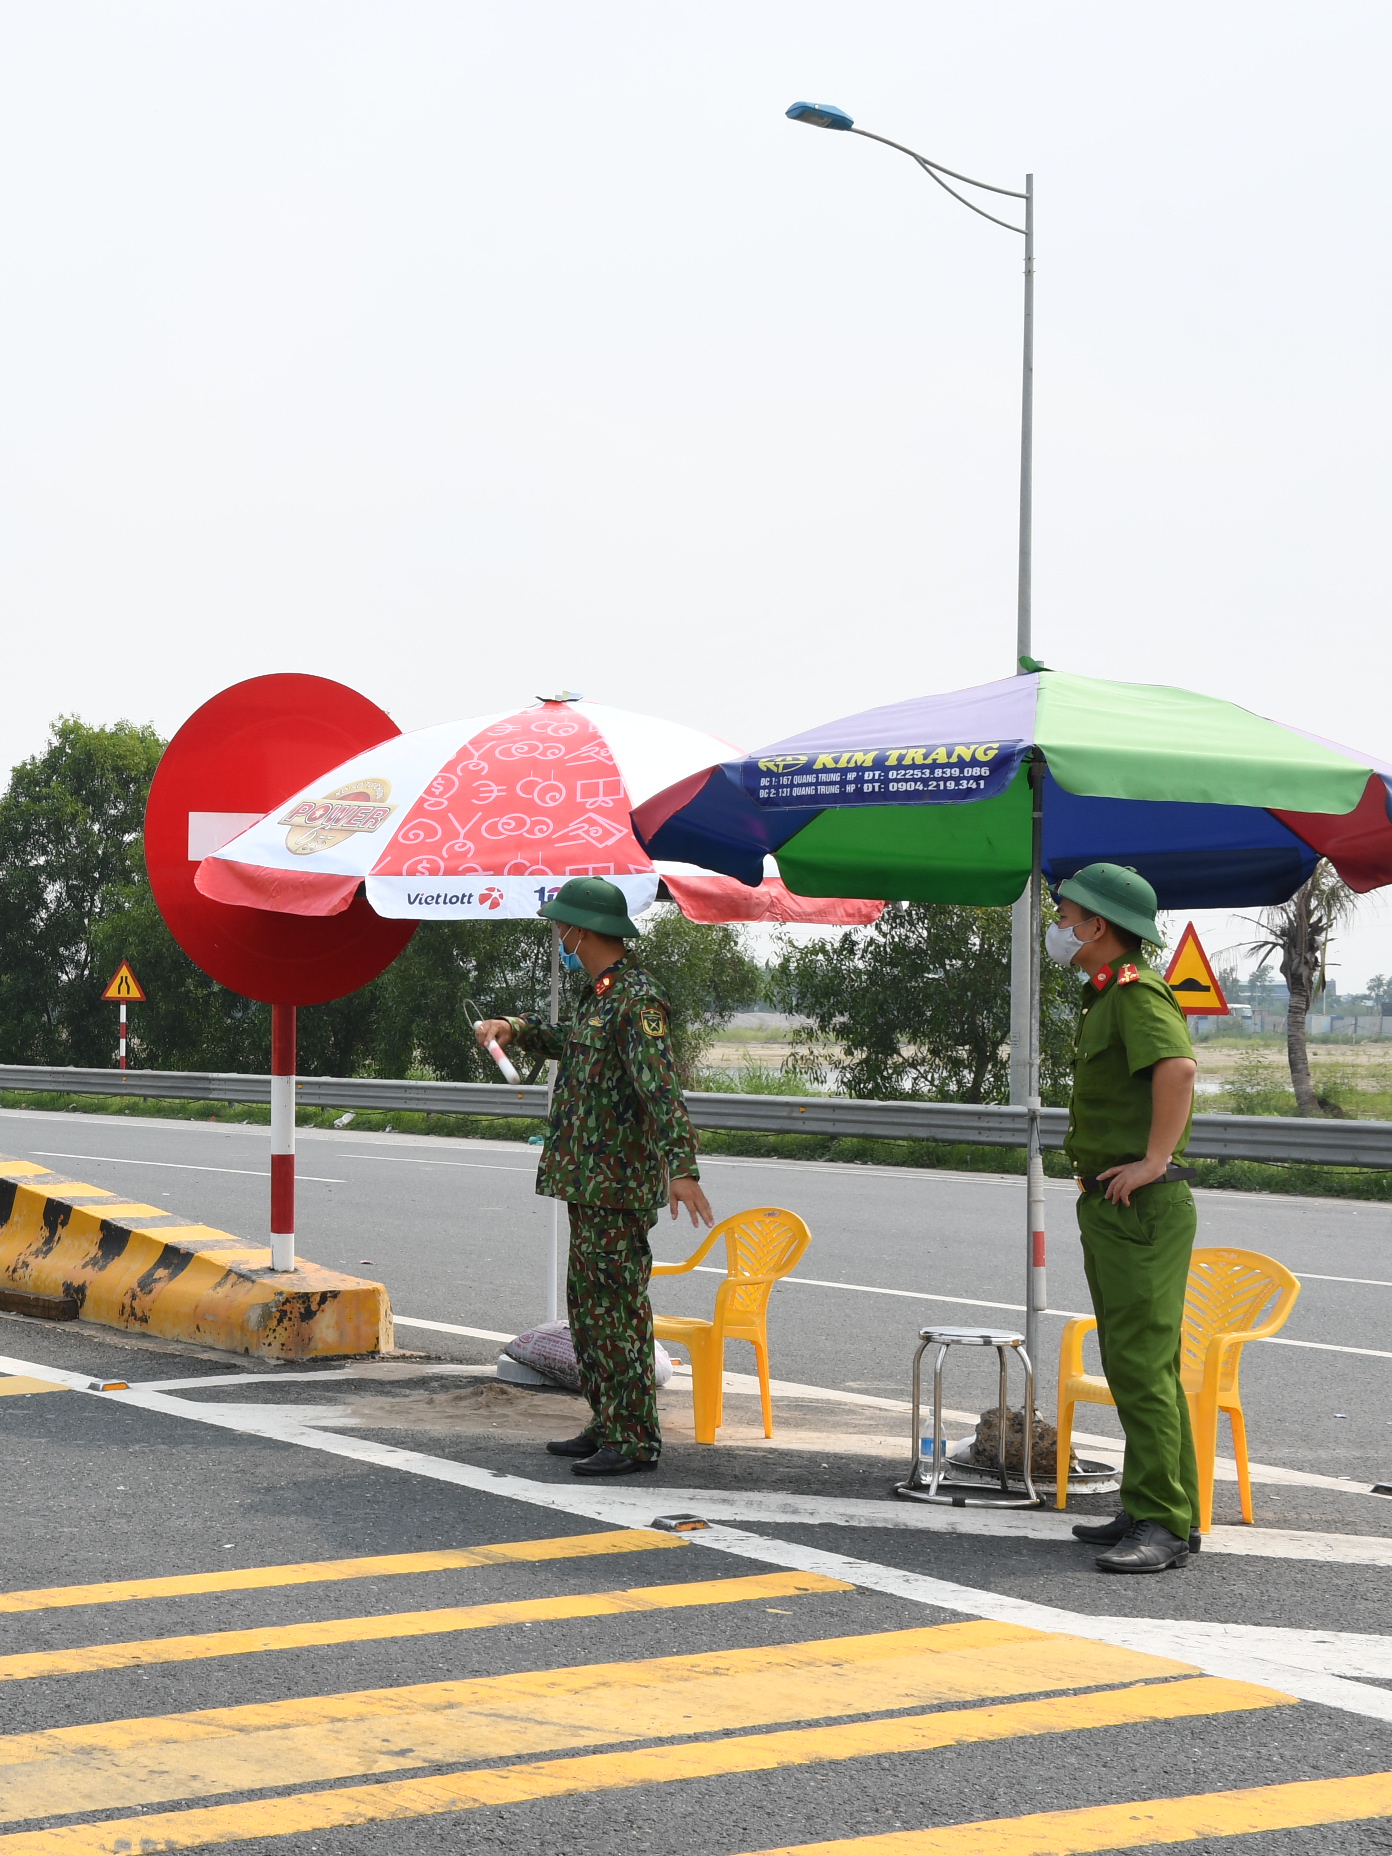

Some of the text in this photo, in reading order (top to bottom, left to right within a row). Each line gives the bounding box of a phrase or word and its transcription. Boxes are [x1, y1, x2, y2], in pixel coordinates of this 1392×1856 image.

[813, 743, 1000, 769] KIM TRANG
[760, 777, 770, 786] ĐC
[771, 777, 778, 785] 1:
[779, 776, 792, 785] 167
[793, 774, 816, 784] QUANG
[818, 773, 841, 783] TRUNG
[847, 772, 857, 781] HP
[864, 770, 884, 780] ĐT:
[888, 767, 990, 779] 02253.839.086
[759, 789, 769, 798] ĐC
[770, 788, 777, 797] 2:
[778, 788, 790, 797] 131
[792, 786, 815, 796] QUANG
[817, 784, 840, 794] TRUNG
[846, 784, 856, 793] HP
[863, 782, 884, 792] ĐT:
[888, 780, 985, 791] 0904.219.341
[283, 802, 391, 829] POWER
[407, 892, 474, 905] Vietlott
